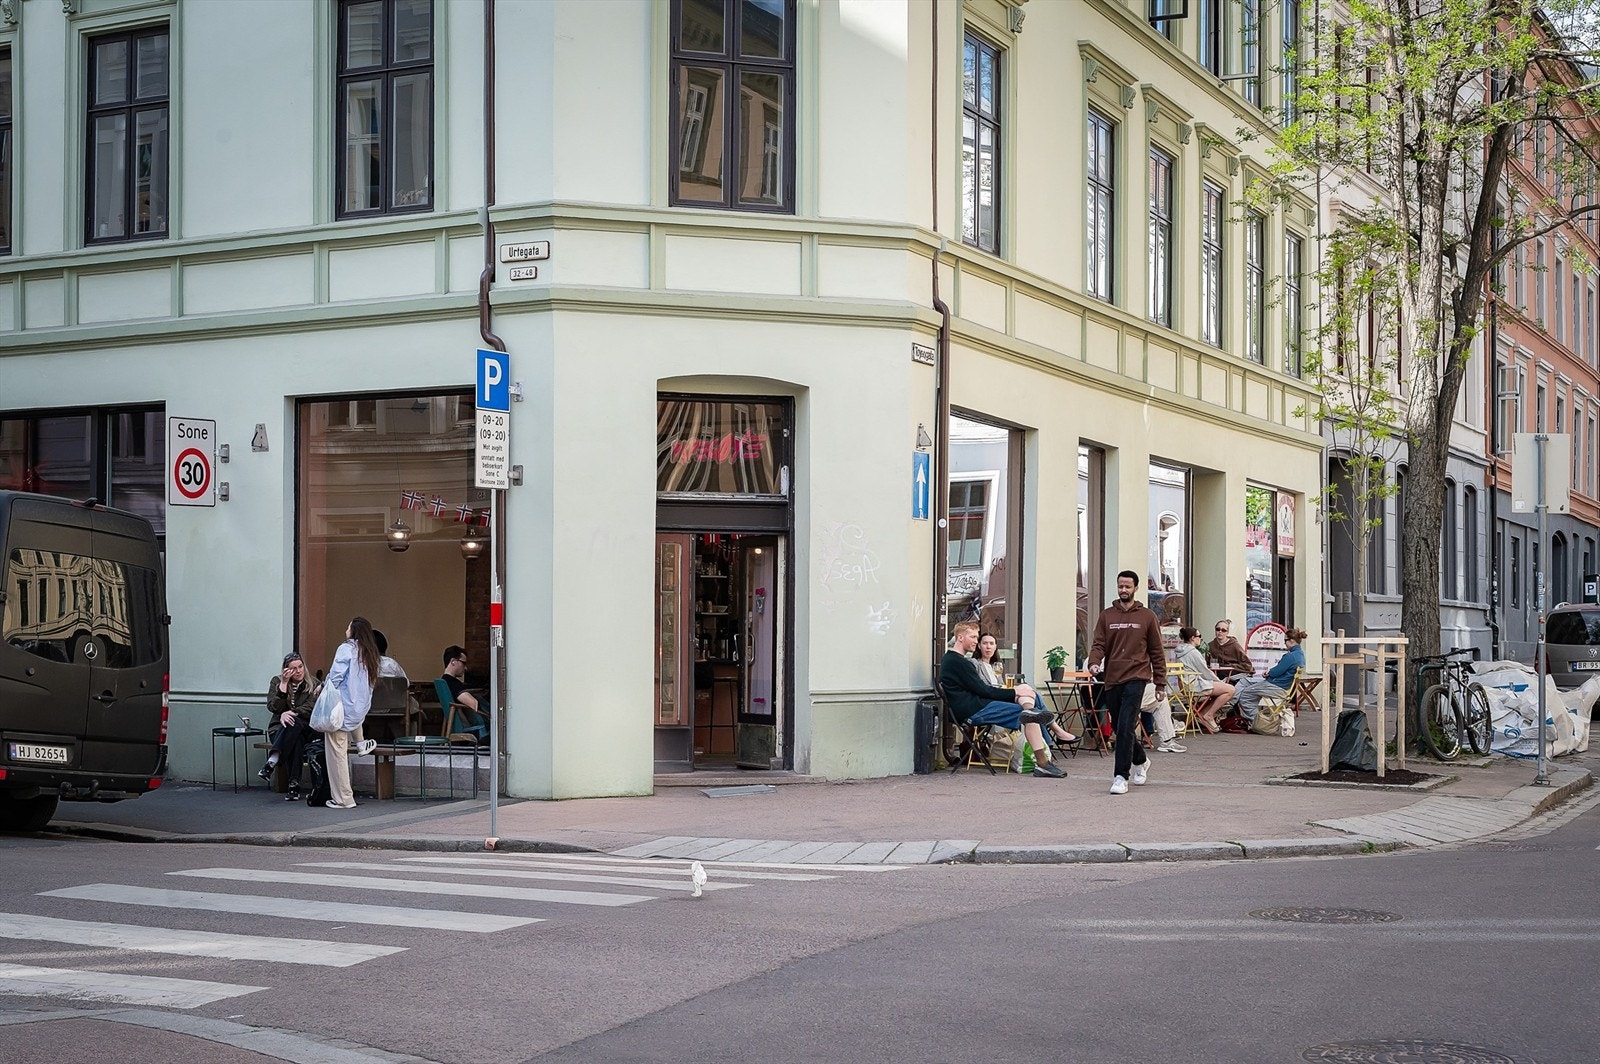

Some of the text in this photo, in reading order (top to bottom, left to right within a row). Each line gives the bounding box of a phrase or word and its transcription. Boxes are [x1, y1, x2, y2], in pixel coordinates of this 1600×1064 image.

[508, 246, 540, 259] Urtegata
[484, 358, 502, 402] P
[482, 414, 504, 426] 09-20
[177, 423, 208, 439] Sone
[480, 430, 506, 442] (09-20)
[181, 461, 204, 486] 30
[1587, 585, 1595, 593] P
[18, 746, 65, 760] HJ 82654
